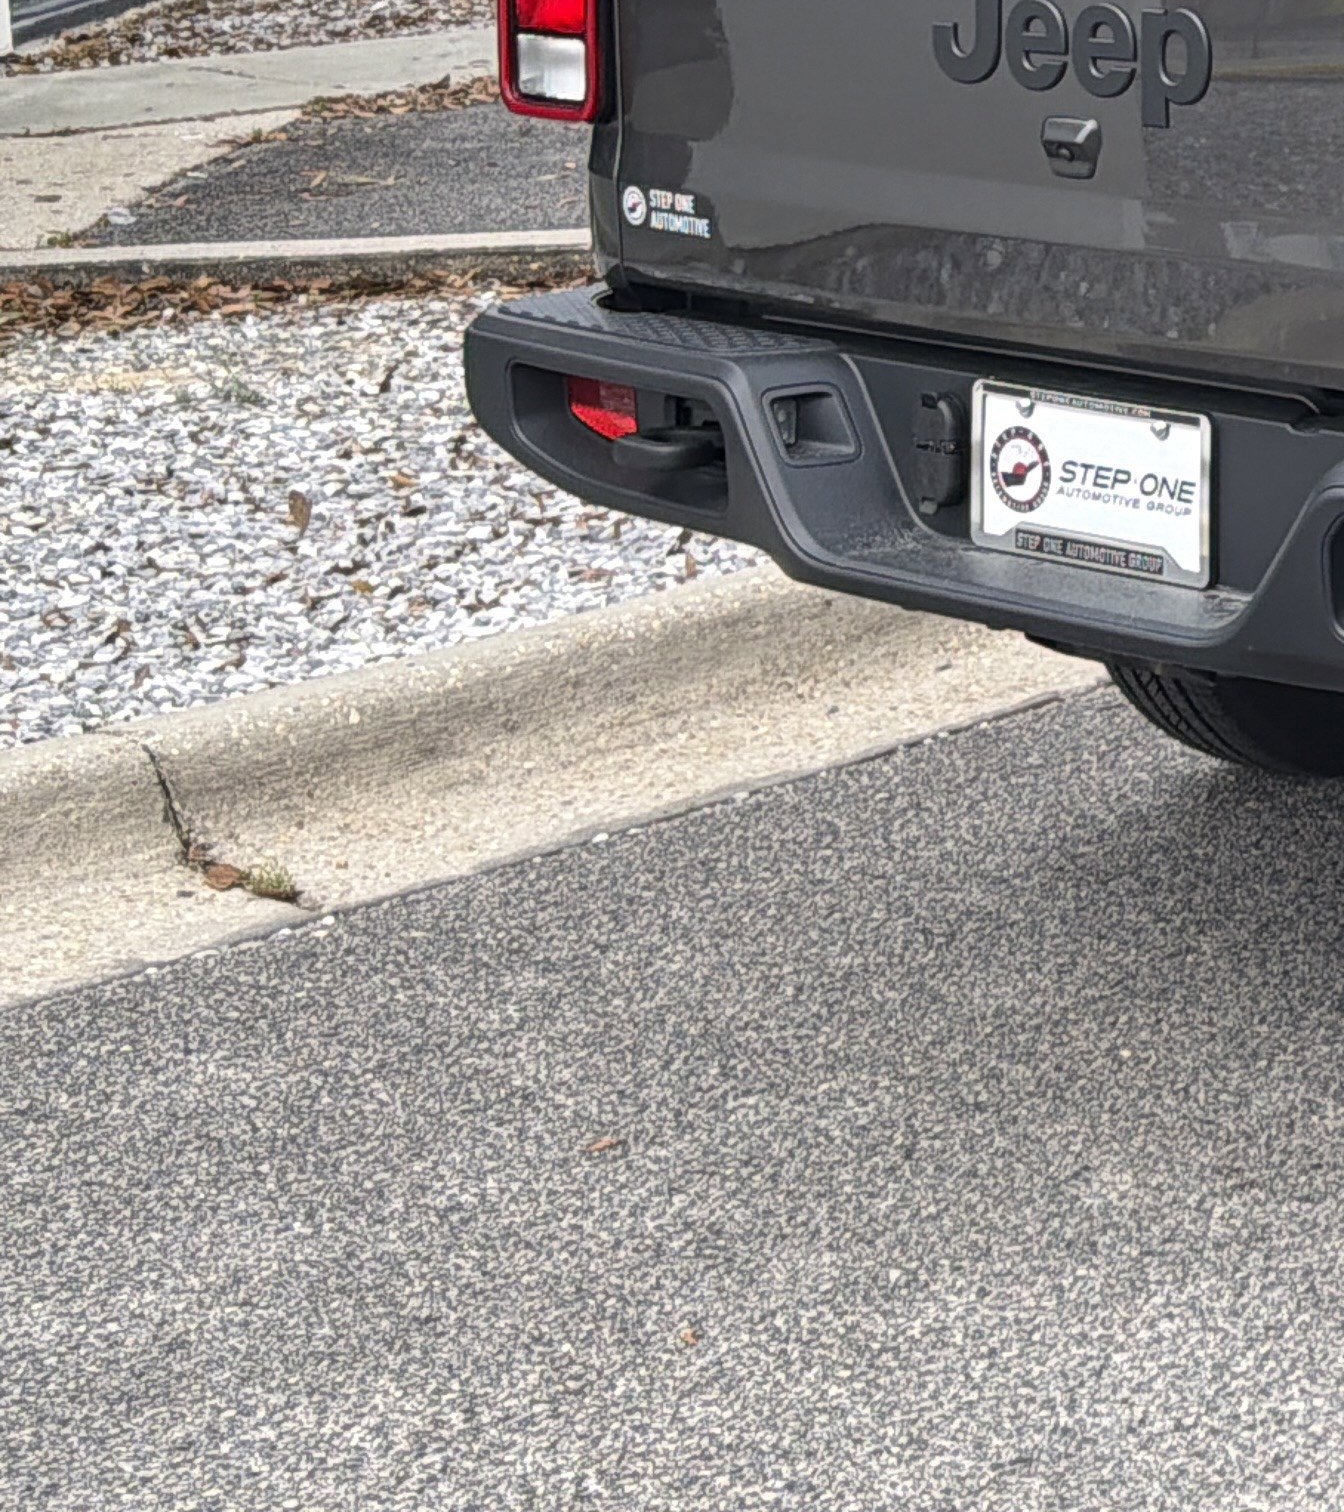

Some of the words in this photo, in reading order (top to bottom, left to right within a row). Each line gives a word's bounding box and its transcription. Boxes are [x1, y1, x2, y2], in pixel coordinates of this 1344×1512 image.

[649, 189, 673, 209] STEP
[675, 193, 696, 215] ONE
[650, 210, 711, 238] AUTOMOTIVE
[1059, 460, 1132, 490] STEP
[1139, 473, 1196, 503] ONE
[1056, 486, 1140, 509] AUTOMOTIVE
[1146, 500, 1192, 516] GROUP
[1016, 532, 1041, 550] STEP
[1043, 538, 1064, 555] ONE
[1066, 541, 1127, 567] AUTOMOTIVE
[1128, 552, 1163, 573] GROUP
